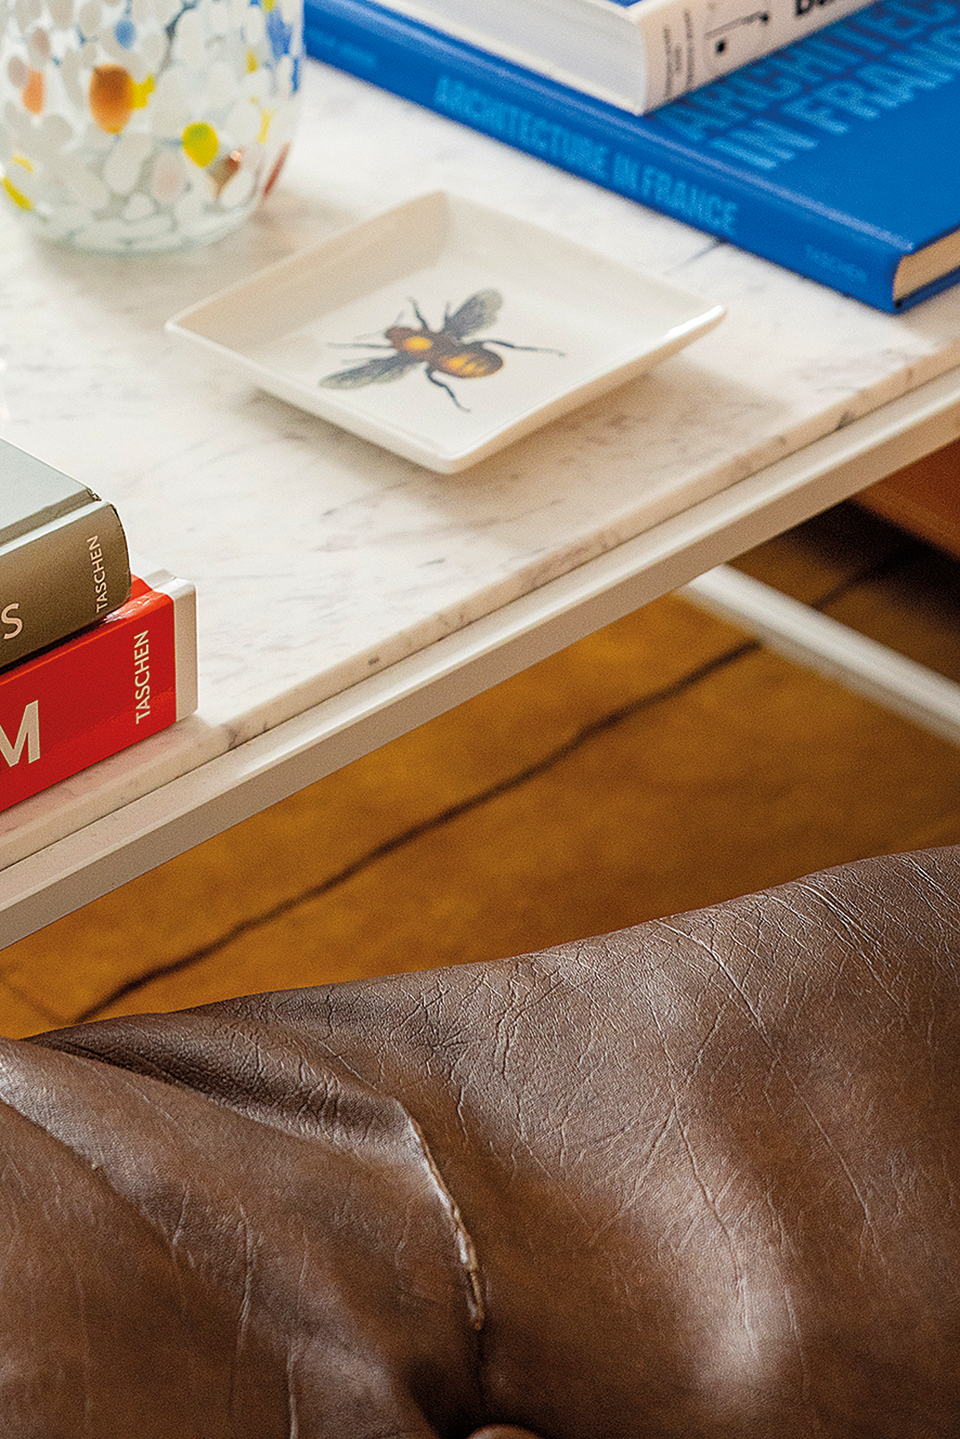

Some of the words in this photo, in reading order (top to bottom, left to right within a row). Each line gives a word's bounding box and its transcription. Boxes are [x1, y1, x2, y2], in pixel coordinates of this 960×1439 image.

[708, 117, 820, 170] IN
[611, 153, 639, 191] IN
[641, 164, 739, 236] FRANCE
[87, 535, 108, 613] TASCHEN
[134, 630, 150, 724] TASCHEN
